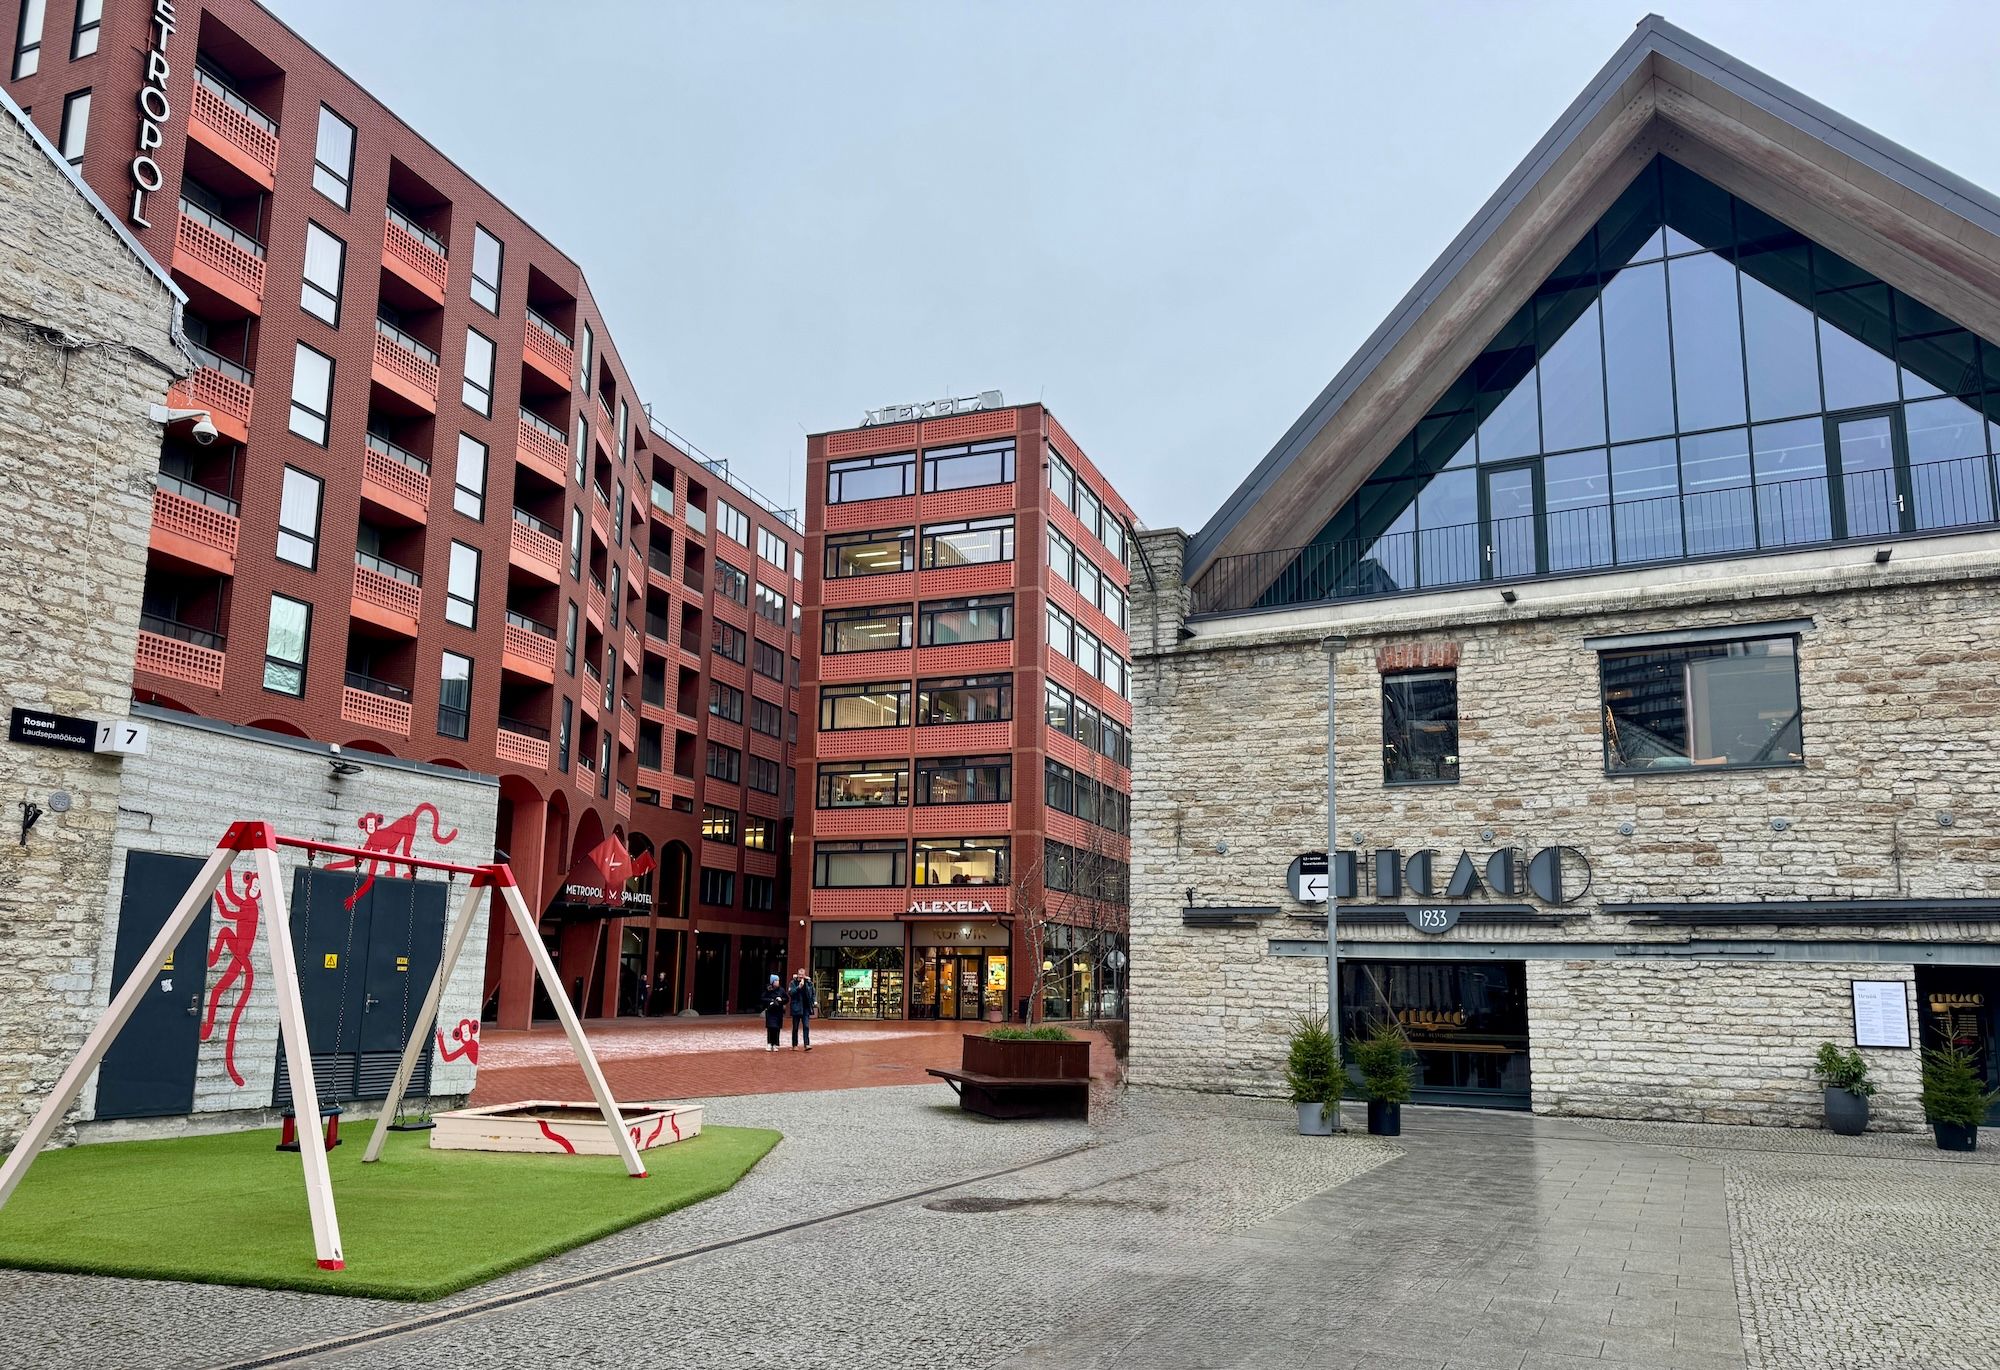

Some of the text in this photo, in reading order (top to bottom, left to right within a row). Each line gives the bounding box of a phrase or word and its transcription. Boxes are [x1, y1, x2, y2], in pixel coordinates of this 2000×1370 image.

[24, 717, 55, 729] Roseni
[103, 728, 111, 743] 7
[126, 729, 138, 744] 7
[566, 884, 653, 904] METROPOL SPA HOTEL
[908, 900, 992, 912] ALEXELA
[1419, 910, 1447, 927] 1933
[841, 929, 878, 940] POOD
